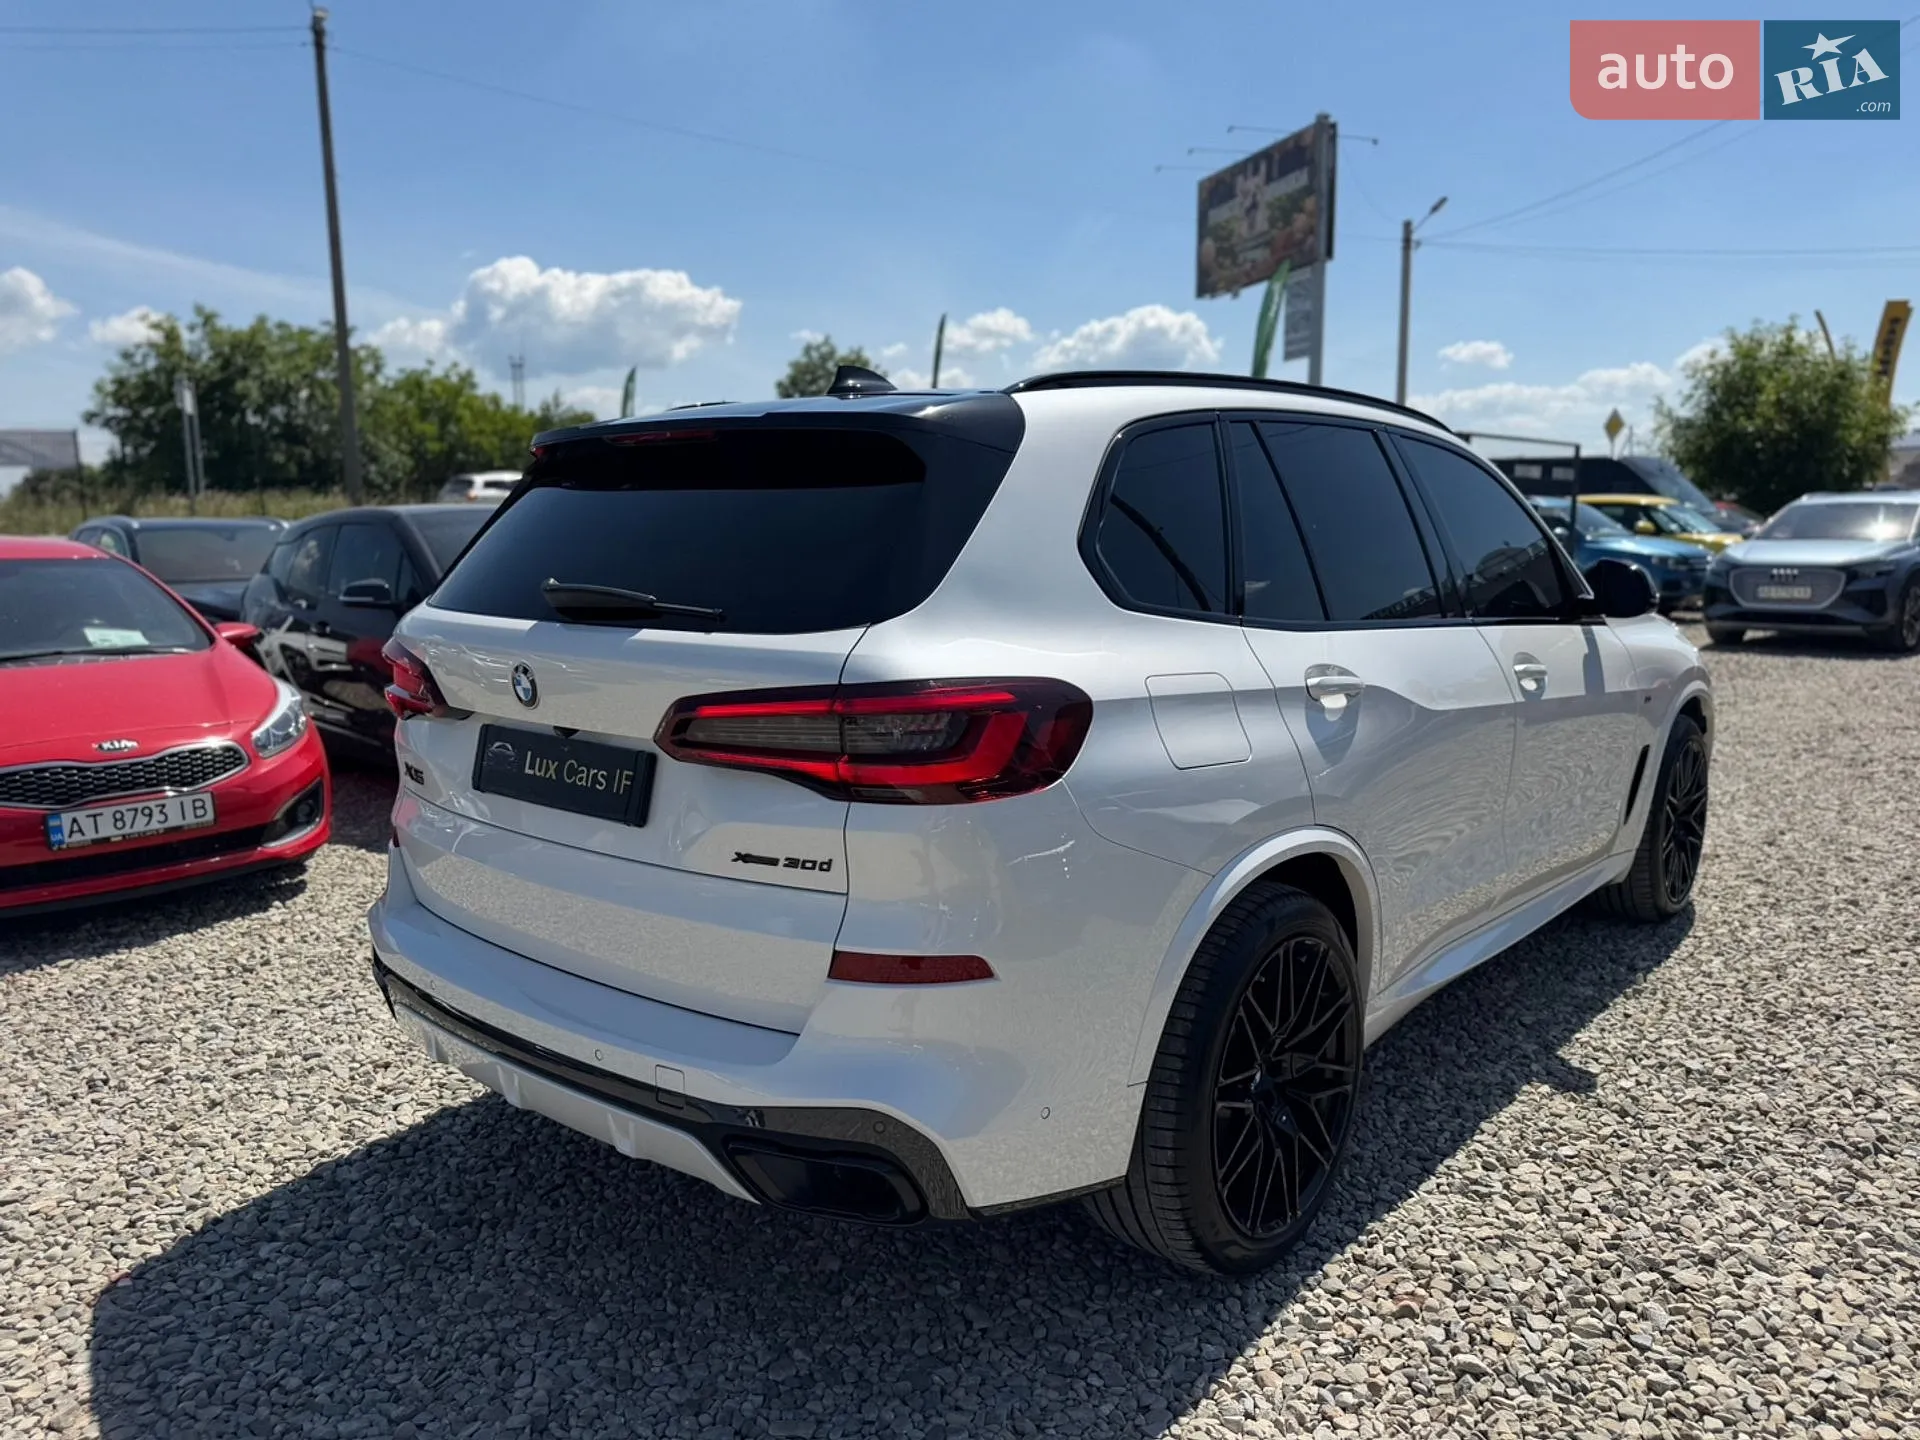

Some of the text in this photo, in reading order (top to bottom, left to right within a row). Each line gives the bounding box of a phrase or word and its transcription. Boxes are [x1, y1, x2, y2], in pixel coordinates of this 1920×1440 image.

[524, 751, 634, 795] Lux Cars IF
[68, 812, 103, 839] AT
[112, 804, 169, 831] 8793
[180, 798, 208, 822] IB
[782, 856, 833, 872] 30d
